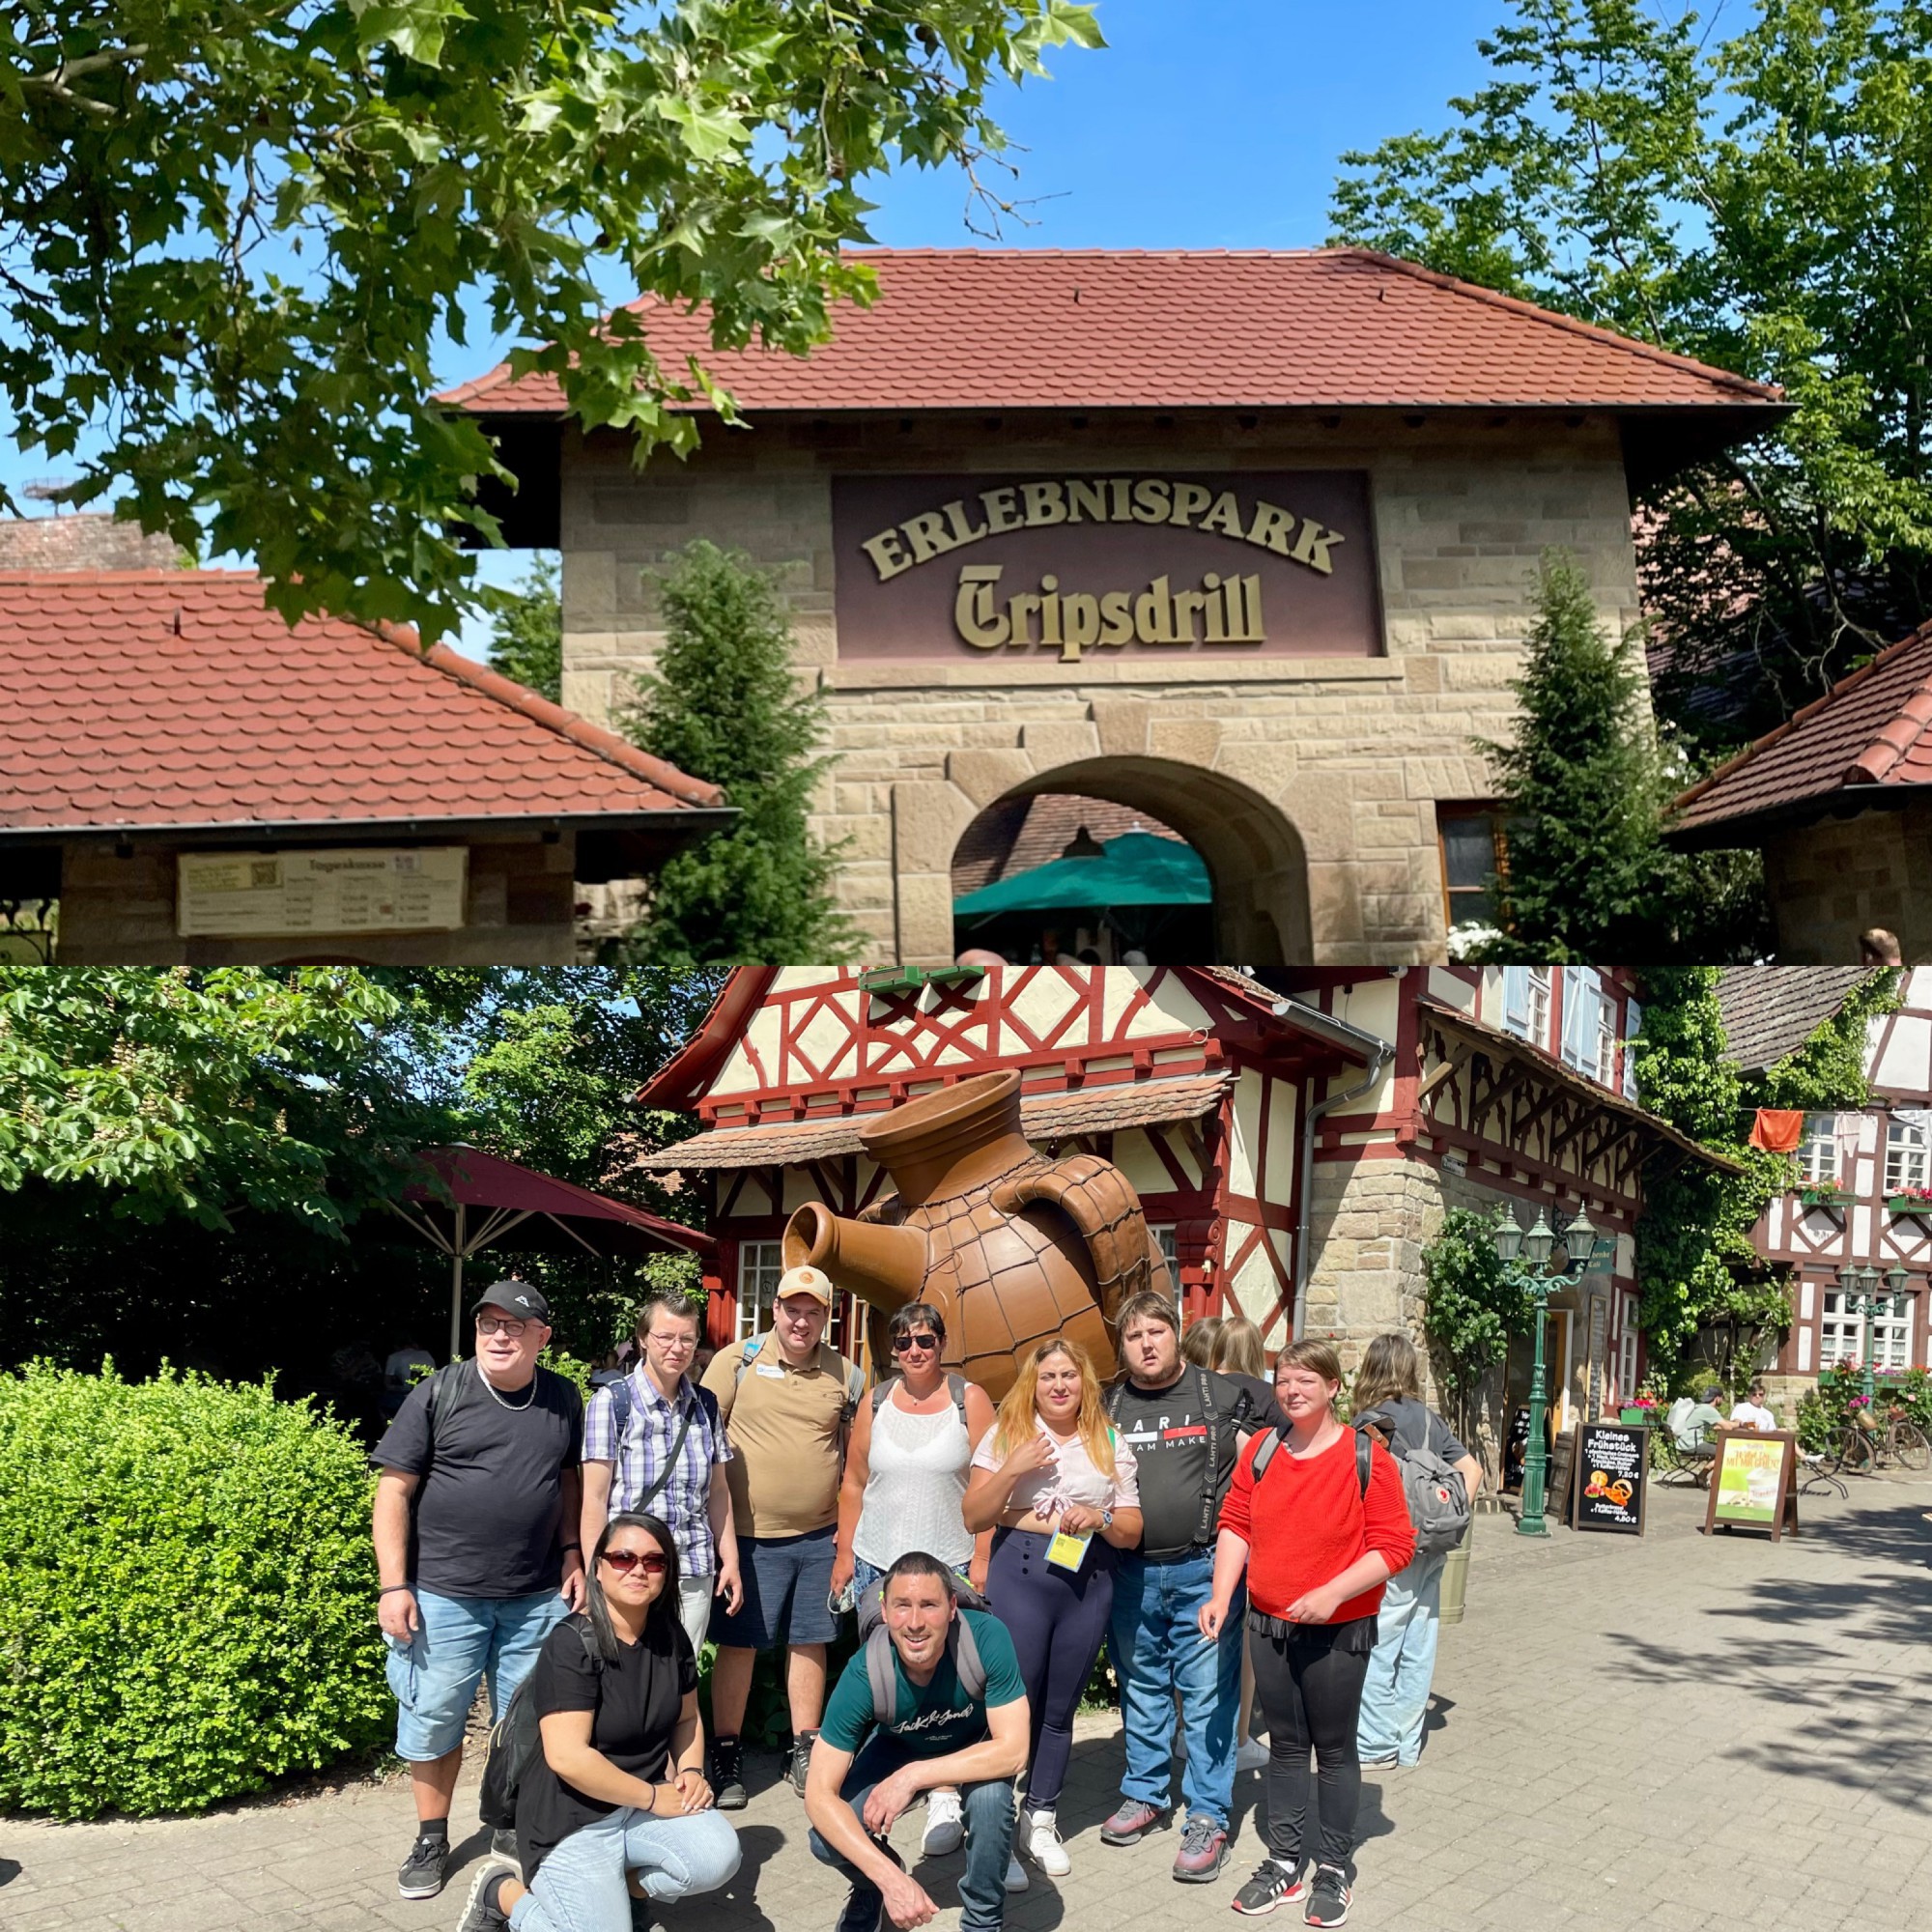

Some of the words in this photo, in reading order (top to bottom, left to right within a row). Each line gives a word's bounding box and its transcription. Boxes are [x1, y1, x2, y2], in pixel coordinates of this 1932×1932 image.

[861, 479, 1346, 582] ERLEBNISPARK
[954, 564, 1267, 663] Tripsdrill
[1202, 1386, 1212, 1407] LAHTI
[1115, 1414, 1190, 1433] ARI
[1128, 1443, 1156, 1452] EAM
[1165, 1435, 1206, 1449] MAKE
[1587, 1438, 1636, 1452] Frühstück
[1596, 1430, 1630, 1442] Kleines
[1201, 1505, 1210, 1529] LAHTI
